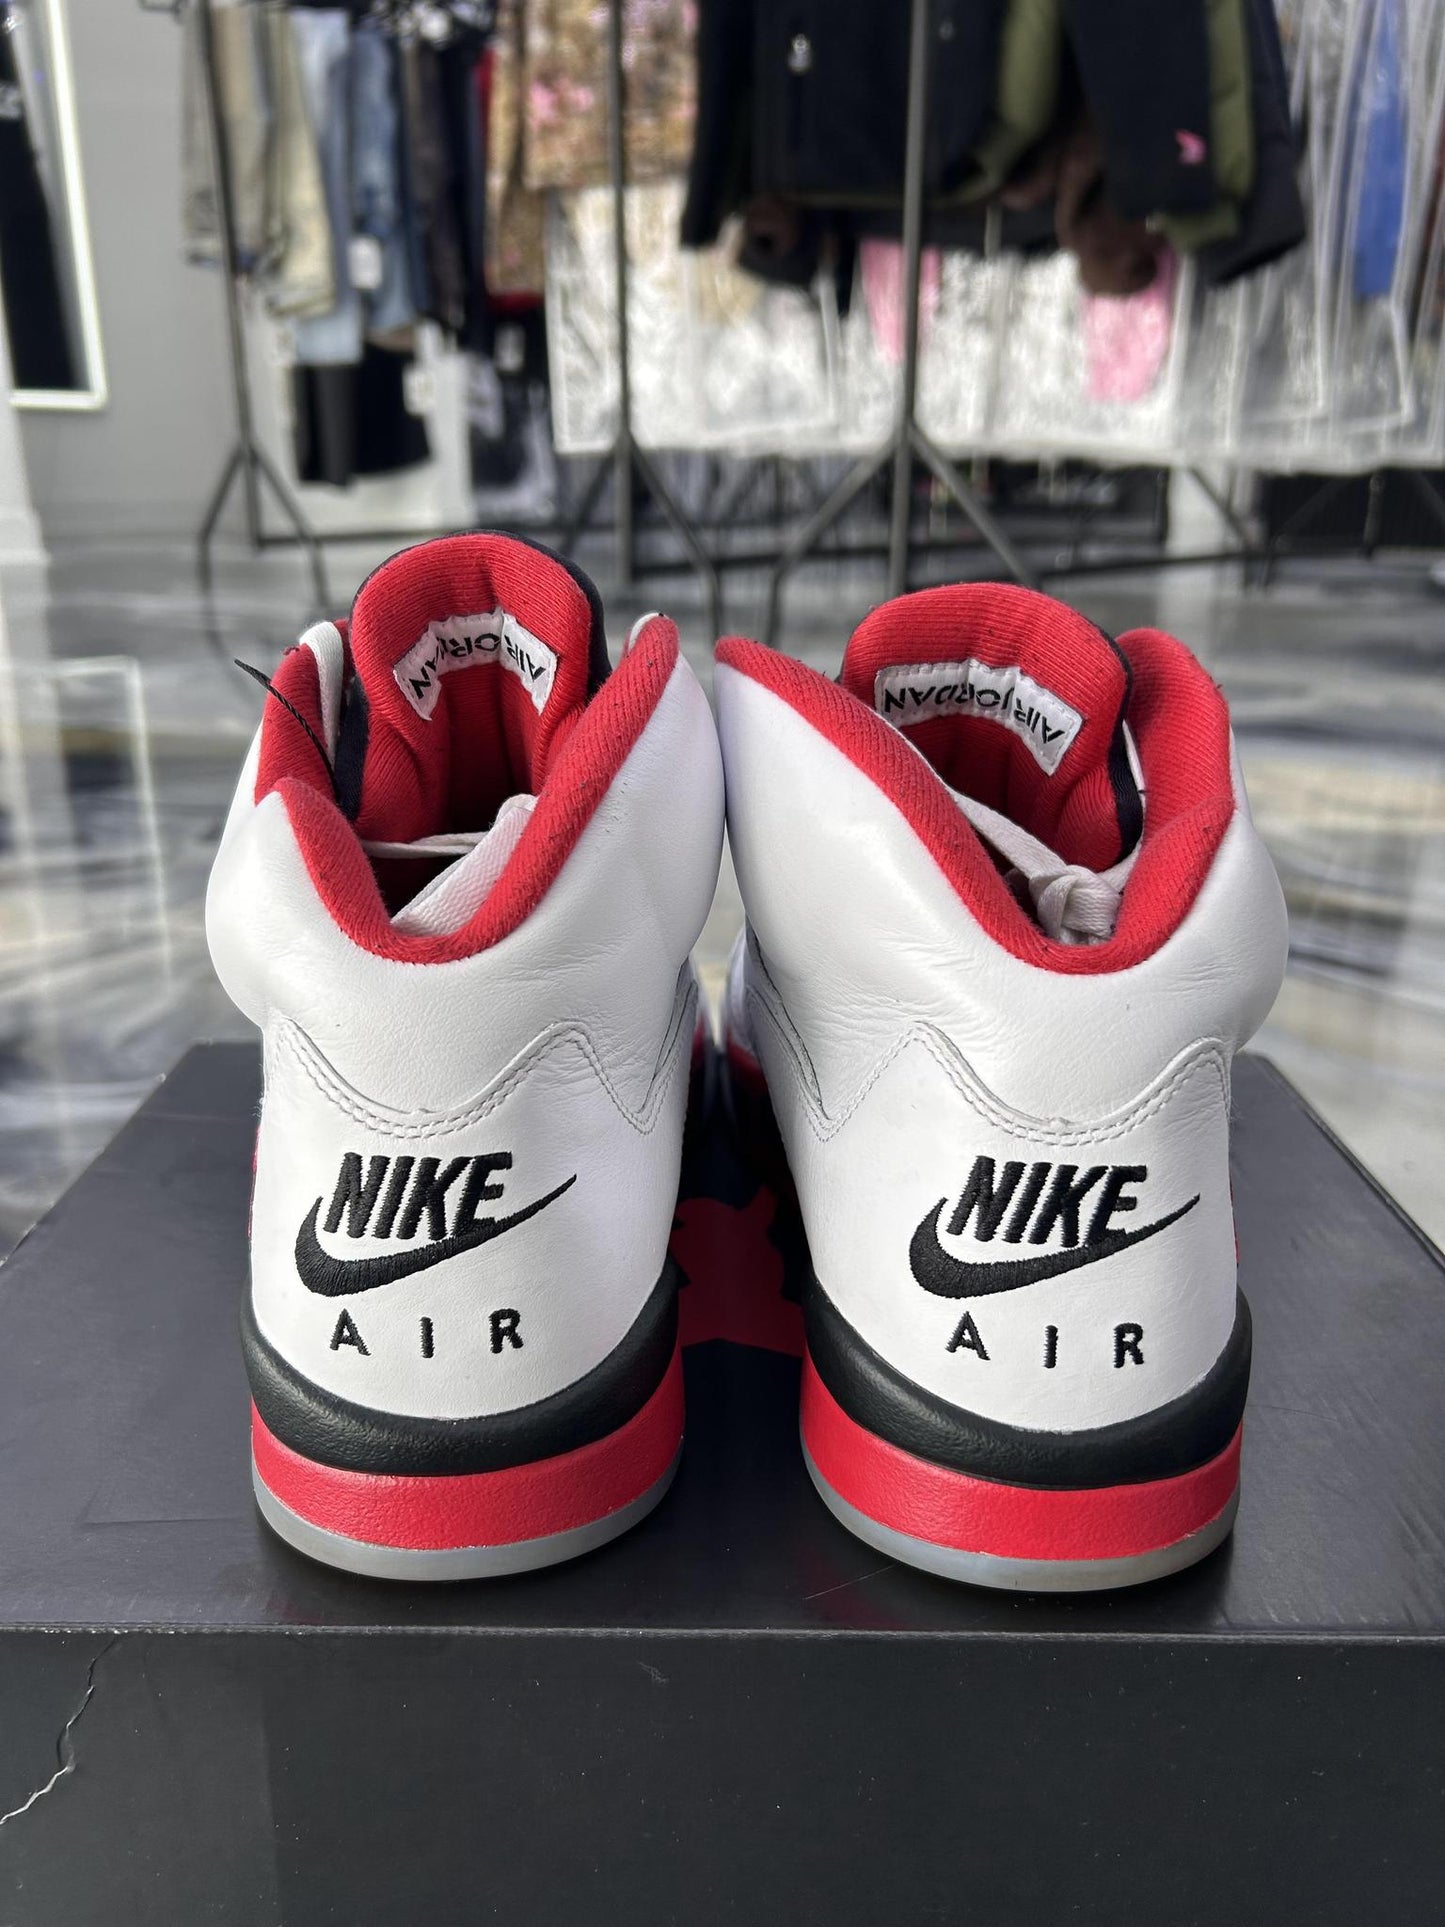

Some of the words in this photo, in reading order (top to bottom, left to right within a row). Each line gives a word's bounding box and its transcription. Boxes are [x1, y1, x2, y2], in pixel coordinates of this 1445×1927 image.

[504, 634, 546, 682] AIR
[885, 683, 1014, 713] JORDAN
[1013, 698, 1065, 744] AIR
[323, 1152, 513, 1241] NIKE
[946, 1155, 1147, 1248] NIKE
[329, 1308, 524, 1360] AIR
[945, 1311, 1144, 1369] AIR
